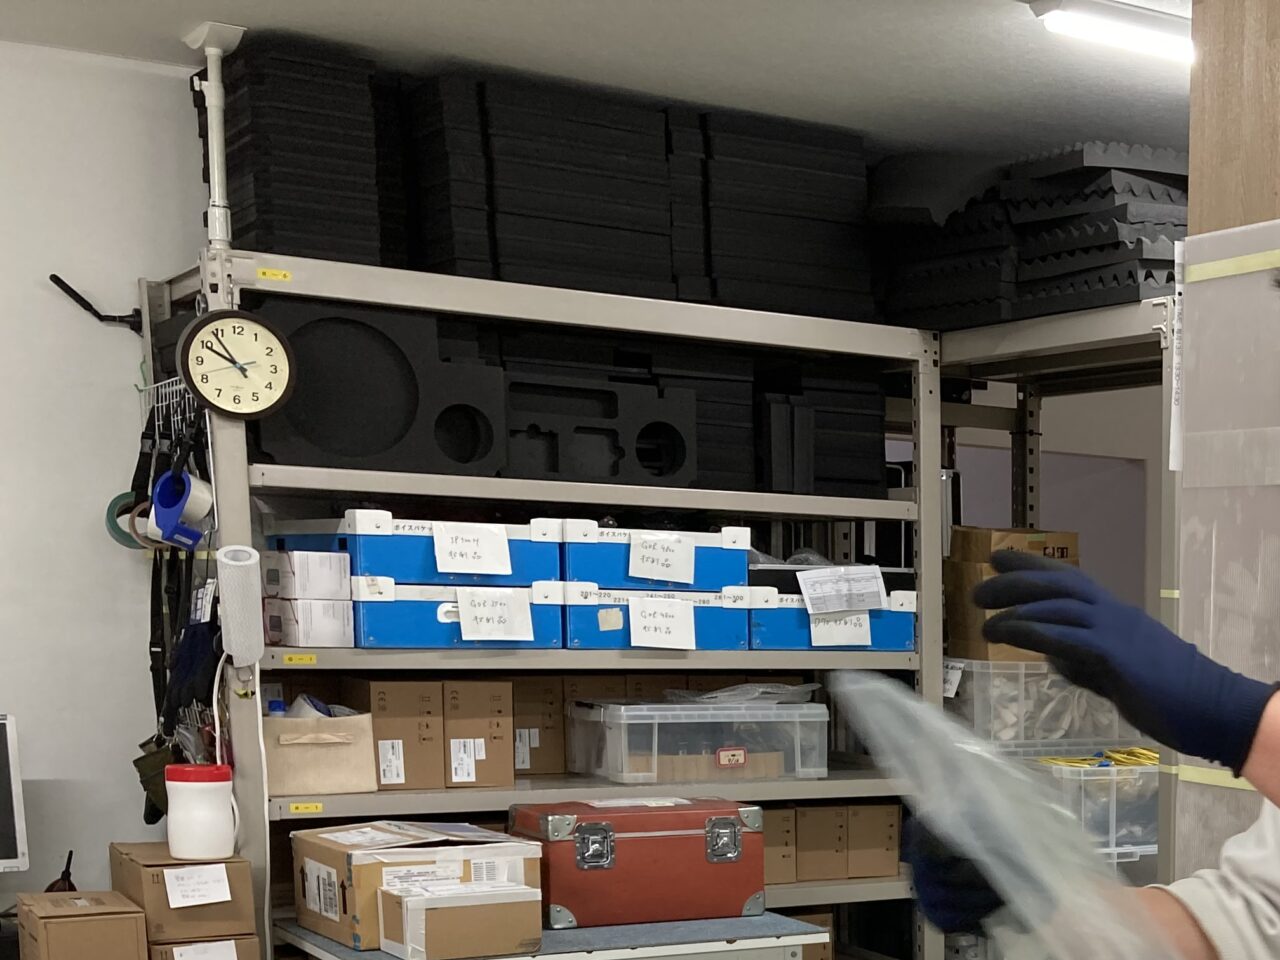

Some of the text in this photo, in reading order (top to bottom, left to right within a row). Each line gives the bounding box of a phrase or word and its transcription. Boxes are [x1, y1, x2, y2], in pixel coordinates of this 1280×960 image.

[214, 328, 224, 338] 11
[232, 325, 245, 335] 12
[254, 333, 258, 342] 1
[200, 340, 213, 349] 10
[265, 347, 273, 356] 2
[195, 356, 204, 366] 9
[270, 364, 278, 374] 3
[200, 374, 209, 384] 8
[264, 381, 273, 390] 4
[214, 388, 222, 397] 7
[252, 392, 259, 401] 5
[233, 394, 241, 404] 6
